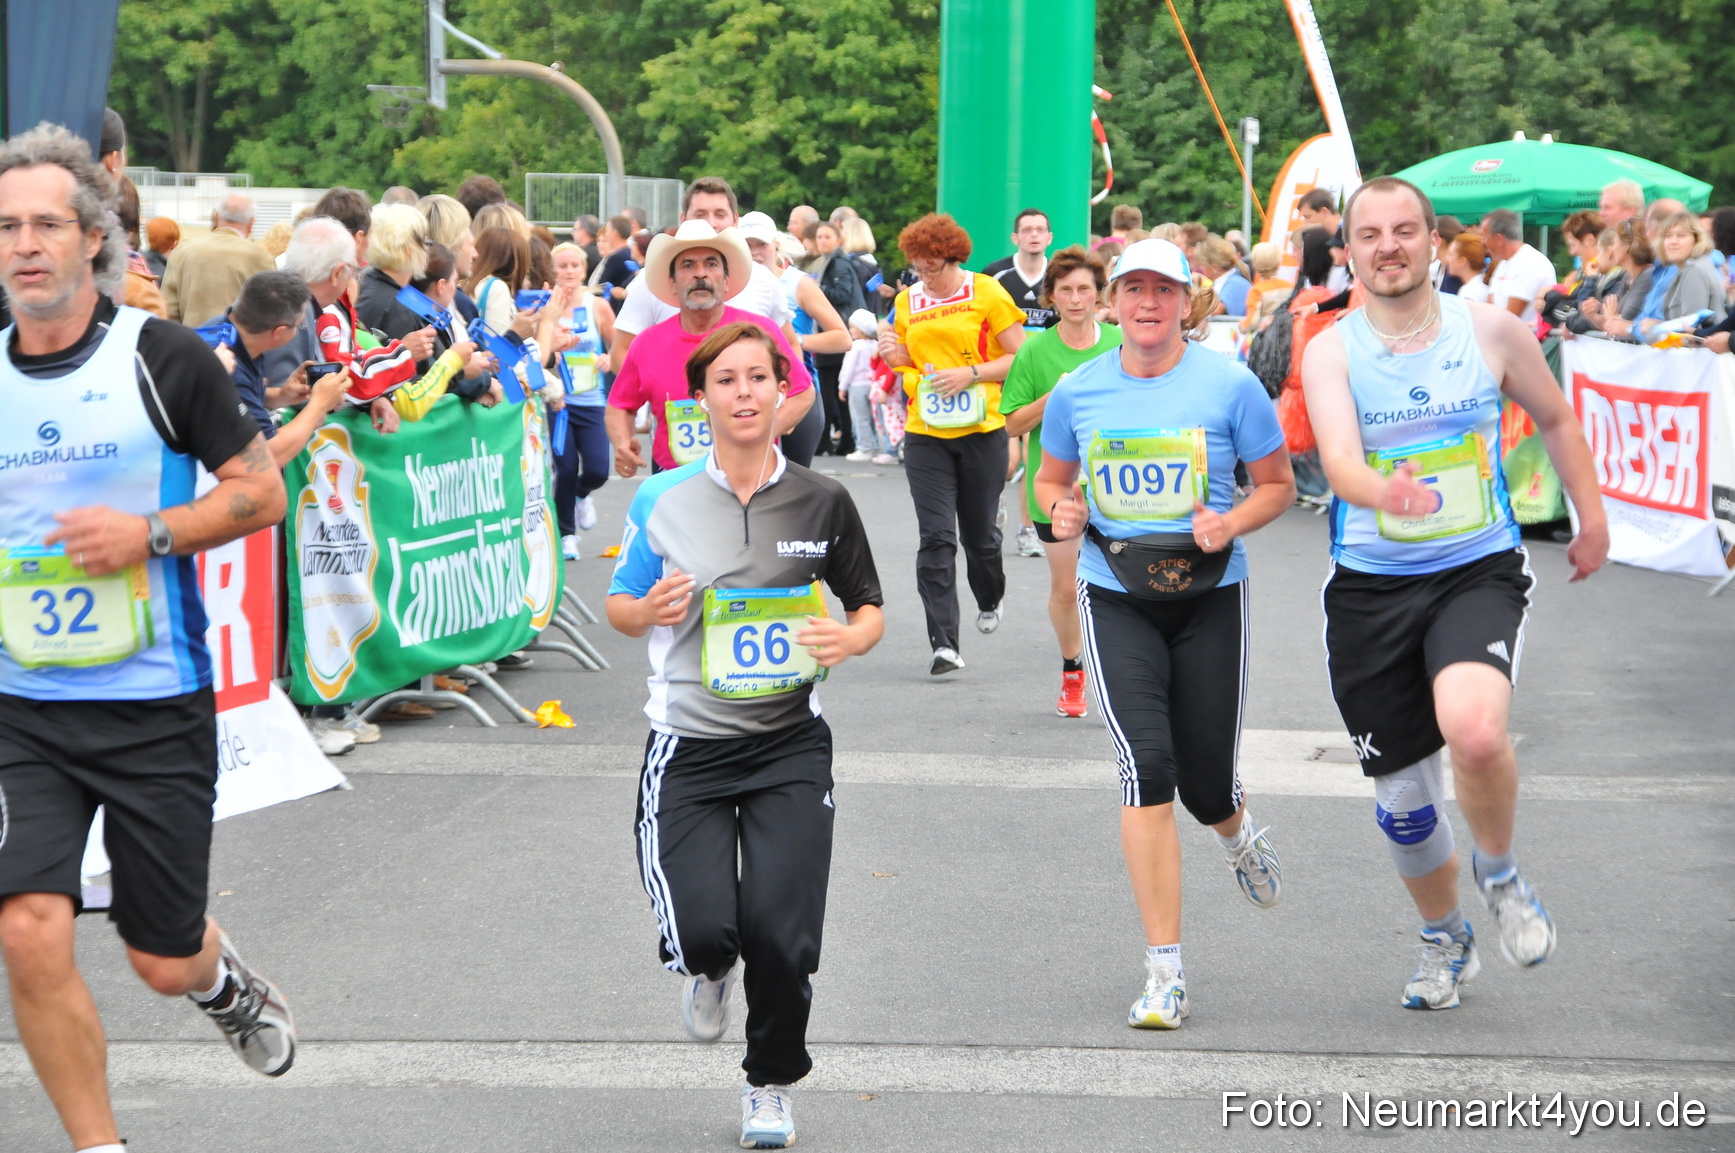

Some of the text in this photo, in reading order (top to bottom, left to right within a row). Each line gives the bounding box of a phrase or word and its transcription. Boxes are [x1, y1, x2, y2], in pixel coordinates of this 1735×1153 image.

[908, 304, 975, 326] MAX BÖGL
[925, 390, 971, 415] 390
[1364, 398, 1480, 426] SCHABMÜLLER
[1580, 387, 1700, 509] MEIER
[404, 437, 507, 529] Neumarkter
[1096, 463, 1188, 496] 1097
[1120, 499, 1149, 509] Margit
[776, 540, 829, 554] LUPINE
[1147, 558, 1192, 574] CAMEL
[387, 518, 526, 648] Lammsbräu
[31, 586, 98, 636] 32
[733, 622, 791, 668] 66
